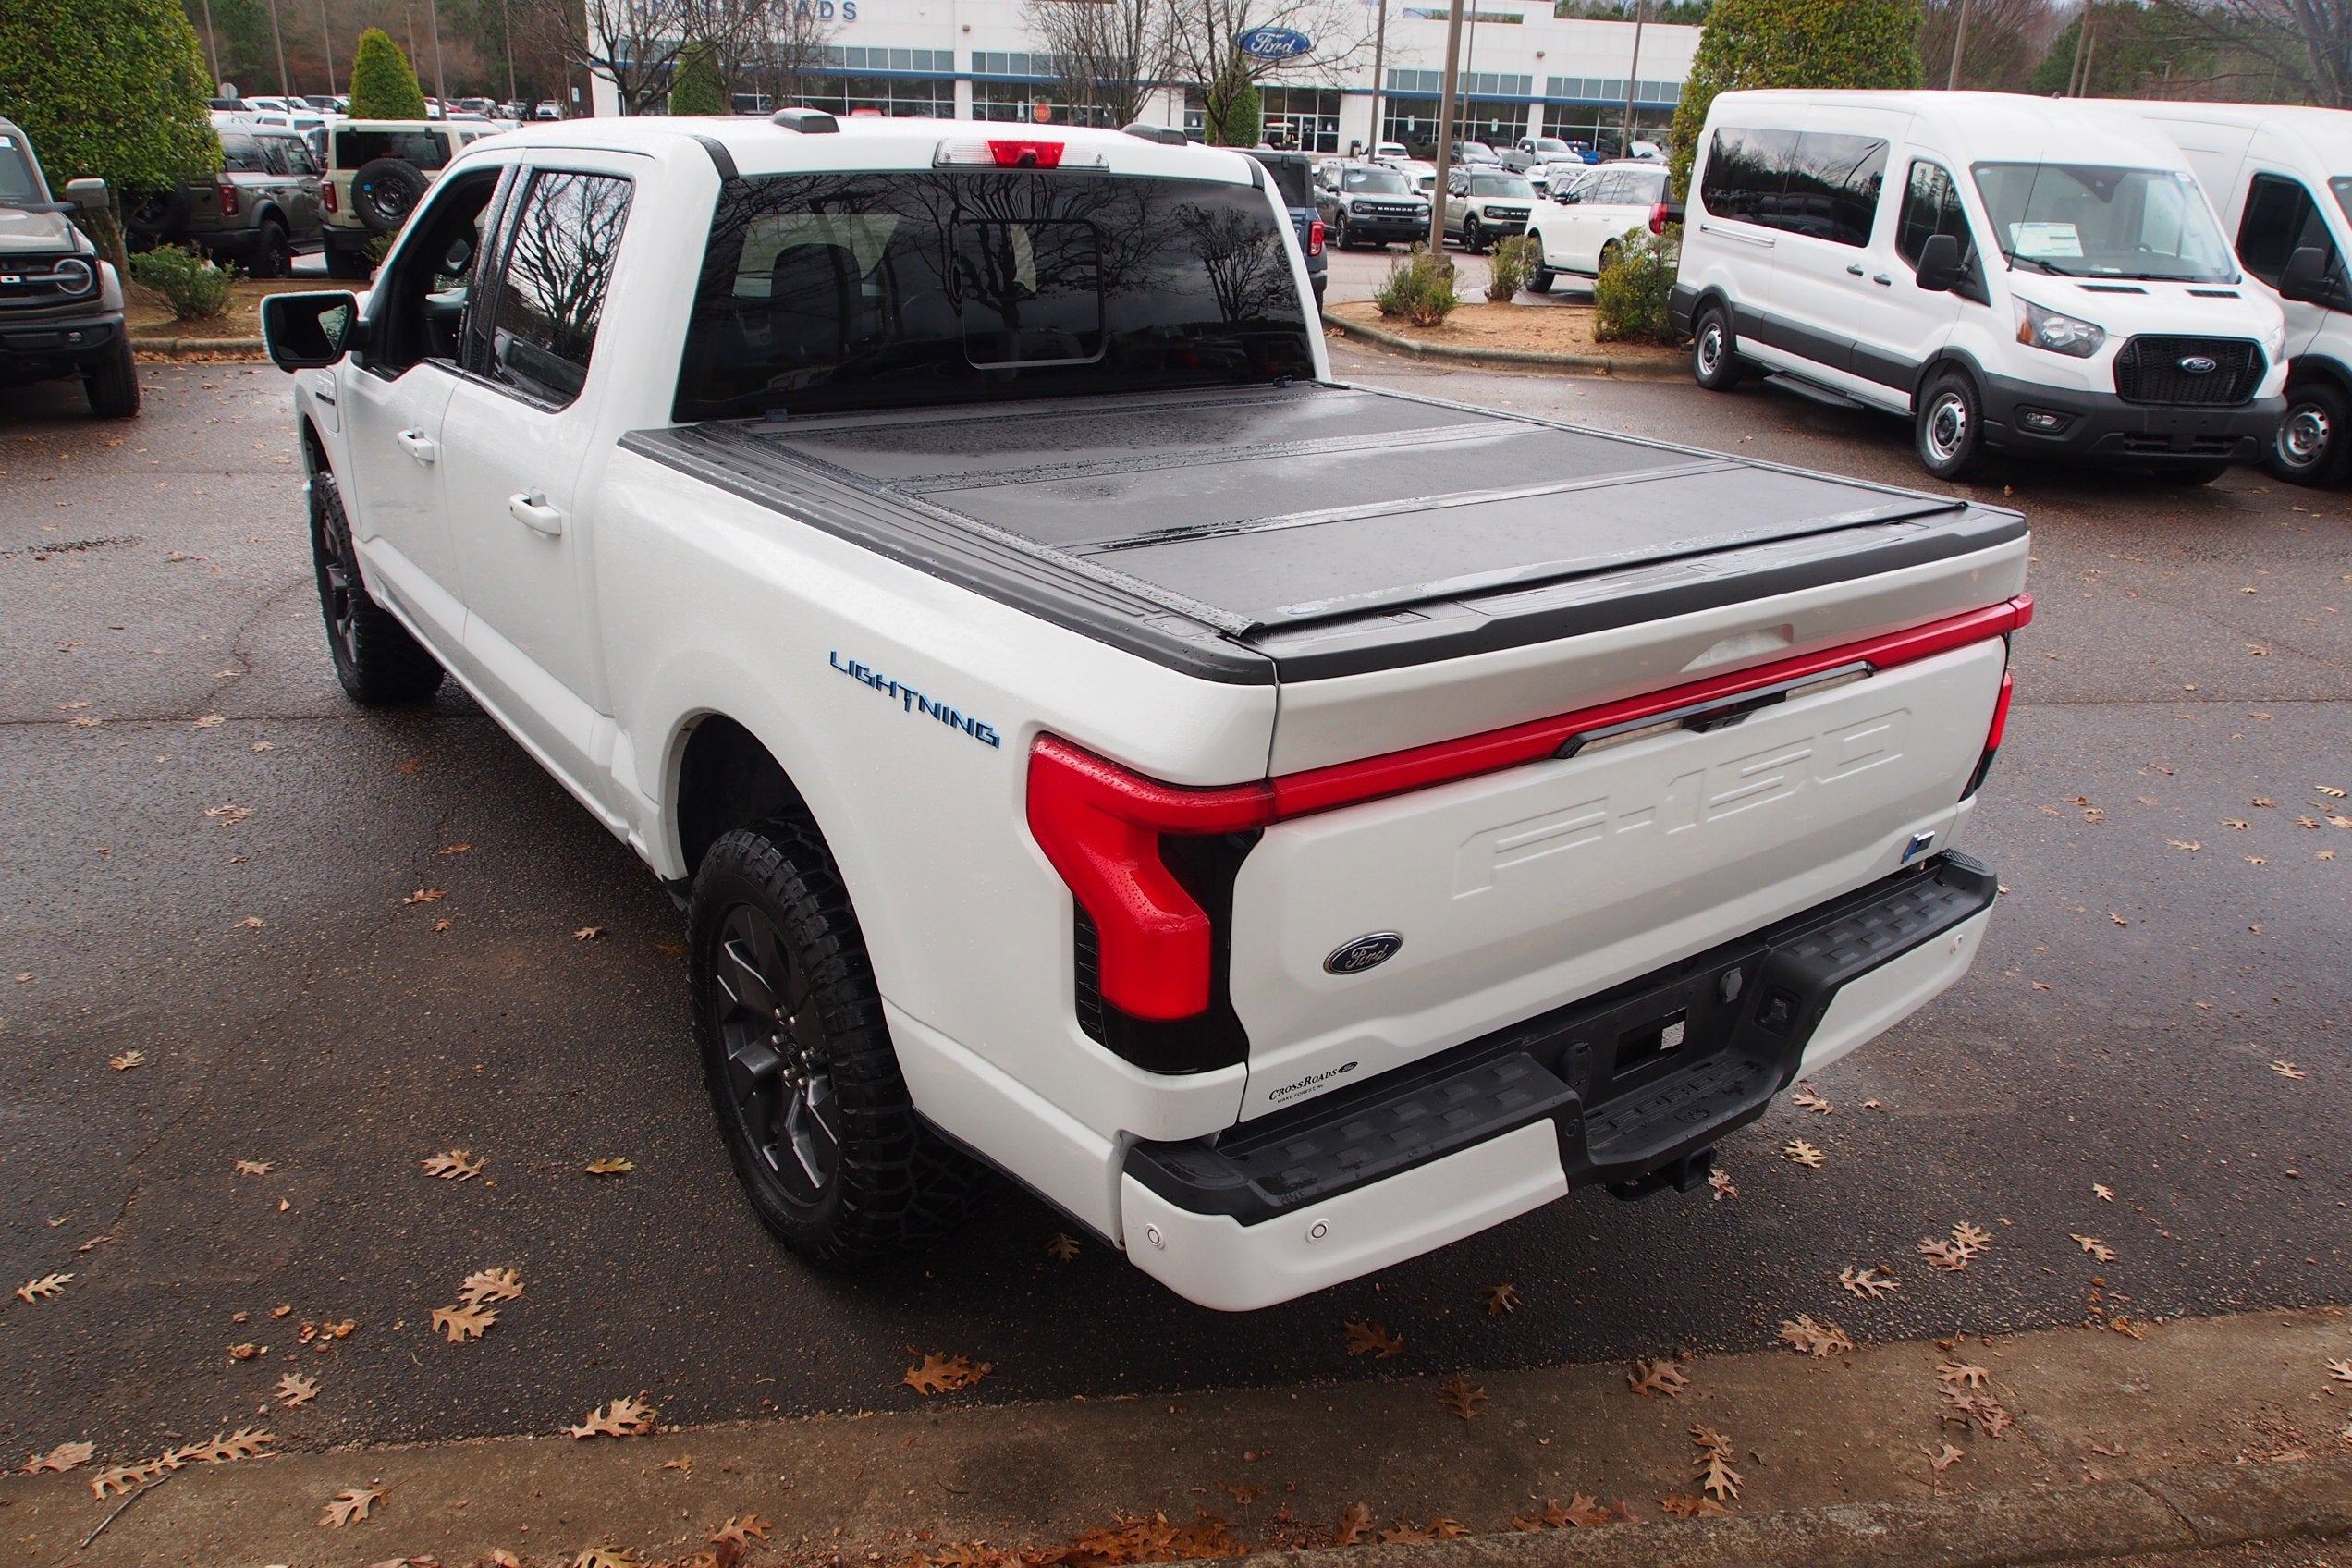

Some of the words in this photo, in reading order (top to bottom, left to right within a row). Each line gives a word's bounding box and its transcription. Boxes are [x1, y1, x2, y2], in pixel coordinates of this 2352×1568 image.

[1251, 32, 1296, 54] Ford
[829, 650, 1001, 750] LIGHTNING
[1452, 707, 1913, 900] F-150
[1344, 942, 1390, 970] Ford
